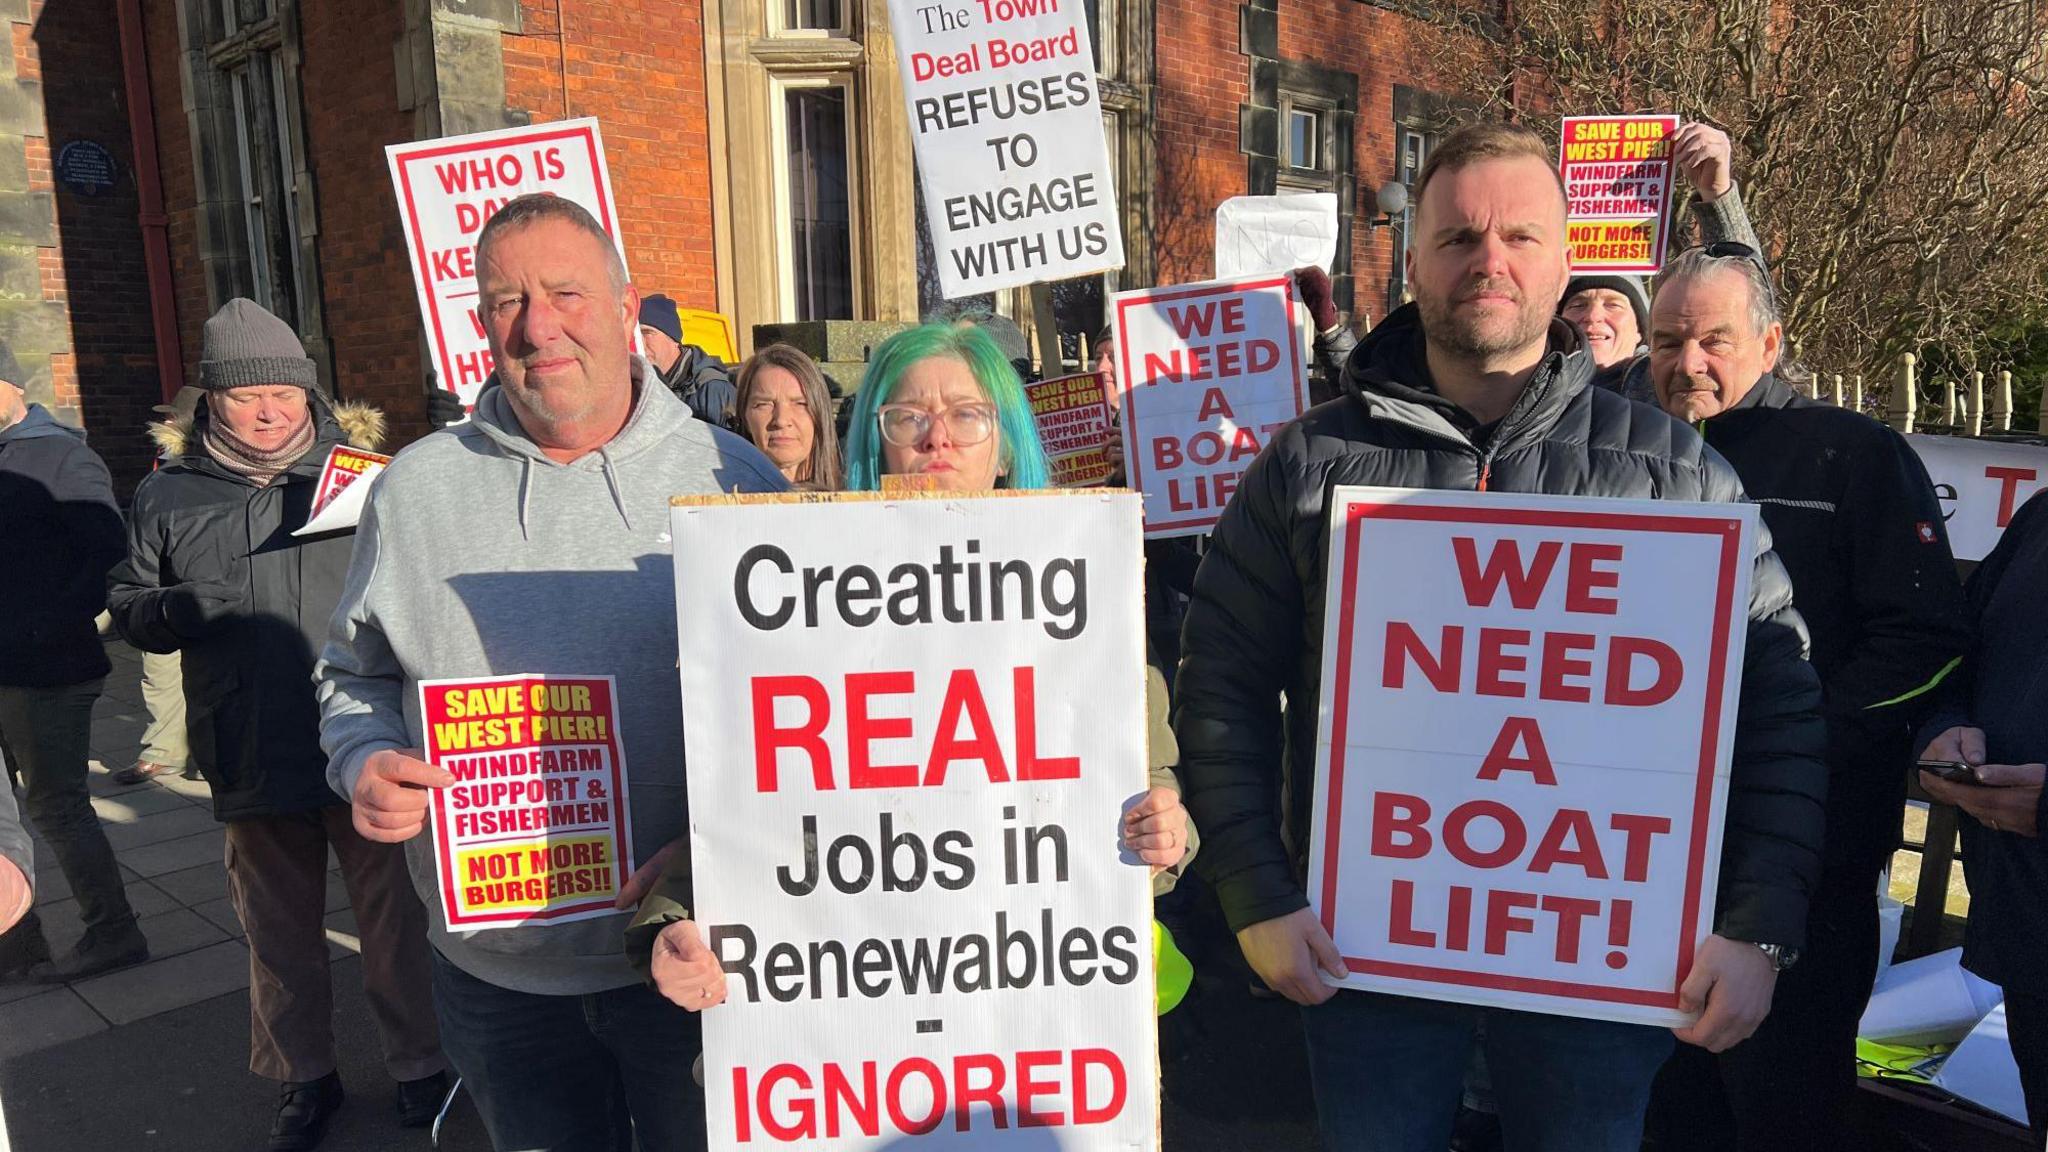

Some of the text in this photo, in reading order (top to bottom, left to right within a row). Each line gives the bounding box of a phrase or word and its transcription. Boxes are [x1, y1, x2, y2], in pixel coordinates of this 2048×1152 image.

[917, 0, 1059, 34] The Town
[911, 27, 1079, 82] Deal Board
[915, 71, 1090, 134] REFUSES
[1566, 140, 1671, 161] WEST PIER!
[1575, 122, 1663, 141] SAVE OUR
[435, 147, 565, 195] WHO IS
[986, 133, 1038, 171] TO
[1568, 182, 1660, 198] SUPPORT &
[1570, 163, 1662, 181] WINDFARM
[944, 173, 1098, 232] ENGAGE
[1567, 199, 1659, 214] FISHERMEN
[951, 222, 1108, 281] WITH US
[1569, 225, 1652, 242] NOT MORE
[1573, 243, 1652, 259] URGERS!!
[432, 246, 479, 282] KE
[1168, 298, 1246, 340] WE
[1144, 339, 1281, 387] NEED
[1032, 377, 1095, 400] SAVE OUR
[1069, 389, 1103, 407] PIER!
[1198, 387, 1235, 422] A
[1040, 421, 1092, 441] SUPPORT
[1168, 472, 1244, 512] LIF
[733, 539, 1087, 640] Creating
[1451, 537, 1623, 615] WE
[1381, 621, 1684, 707] NEED
[445, 684, 592, 718] SAVE OUR
[434, 715, 607, 750] WEST PIER!
[751, 666, 1081, 793] REAL
[447, 748, 603, 782] WINDFARM
[1475, 716, 1558, 786] A
[451, 777, 607, 809] SUPPORT &
[455, 801, 609, 837] FISHERMEN
[1370, 791, 1671, 883] BOAT
[468, 842, 604, 882] NOT MORE
[775, 805, 1069, 897] Jobs in
[466, 867, 612, 905] BURGERS!!
[1388, 879, 1633, 971] LIFT!
[709, 908, 1138, 1003] Renewables
[731, 1047, 1127, 1143] IGNORED
